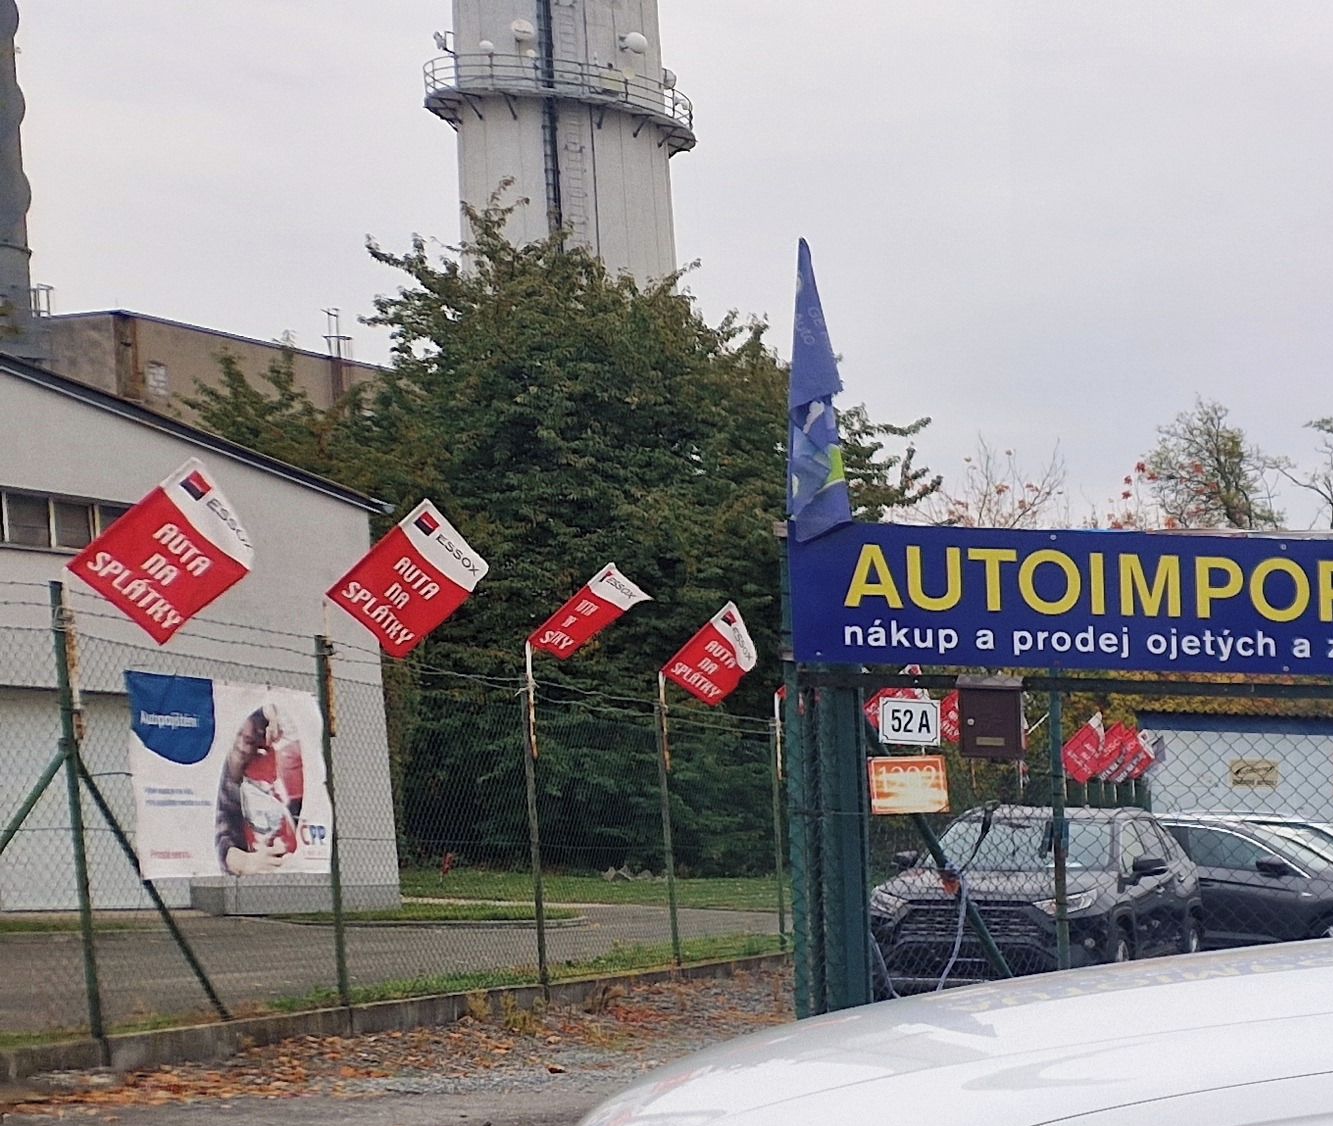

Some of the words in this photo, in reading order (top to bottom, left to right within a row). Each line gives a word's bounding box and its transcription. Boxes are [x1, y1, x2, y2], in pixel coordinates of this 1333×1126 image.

[140, 552, 179, 587] NA
[152, 523, 214, 577] AUTA
[435, 533, 480, 576] ESSOX
[86, 551, 184, 629] SPLÁTKY
[383, 582, 411, 609] NA
[392, 556, 441, 600] AUTA
[606, 577, 637, 599] ESSOX
[341, 581, 416, 645] SPLÁTKY
[704, 640, 737, 669] AUTA
[843, 619, 959, 654] nákup
[974, 628, 996, 650] a
[1012, 625, 1131, 659] prodej
[1146, 627, 1277, 662] ojetých
[1292, 635, 1312, 659] a
[670, 661, 722, 698] SPLÁTKY
[891, 708, 914, 733] 52
[918, 709, 931, 734] A
